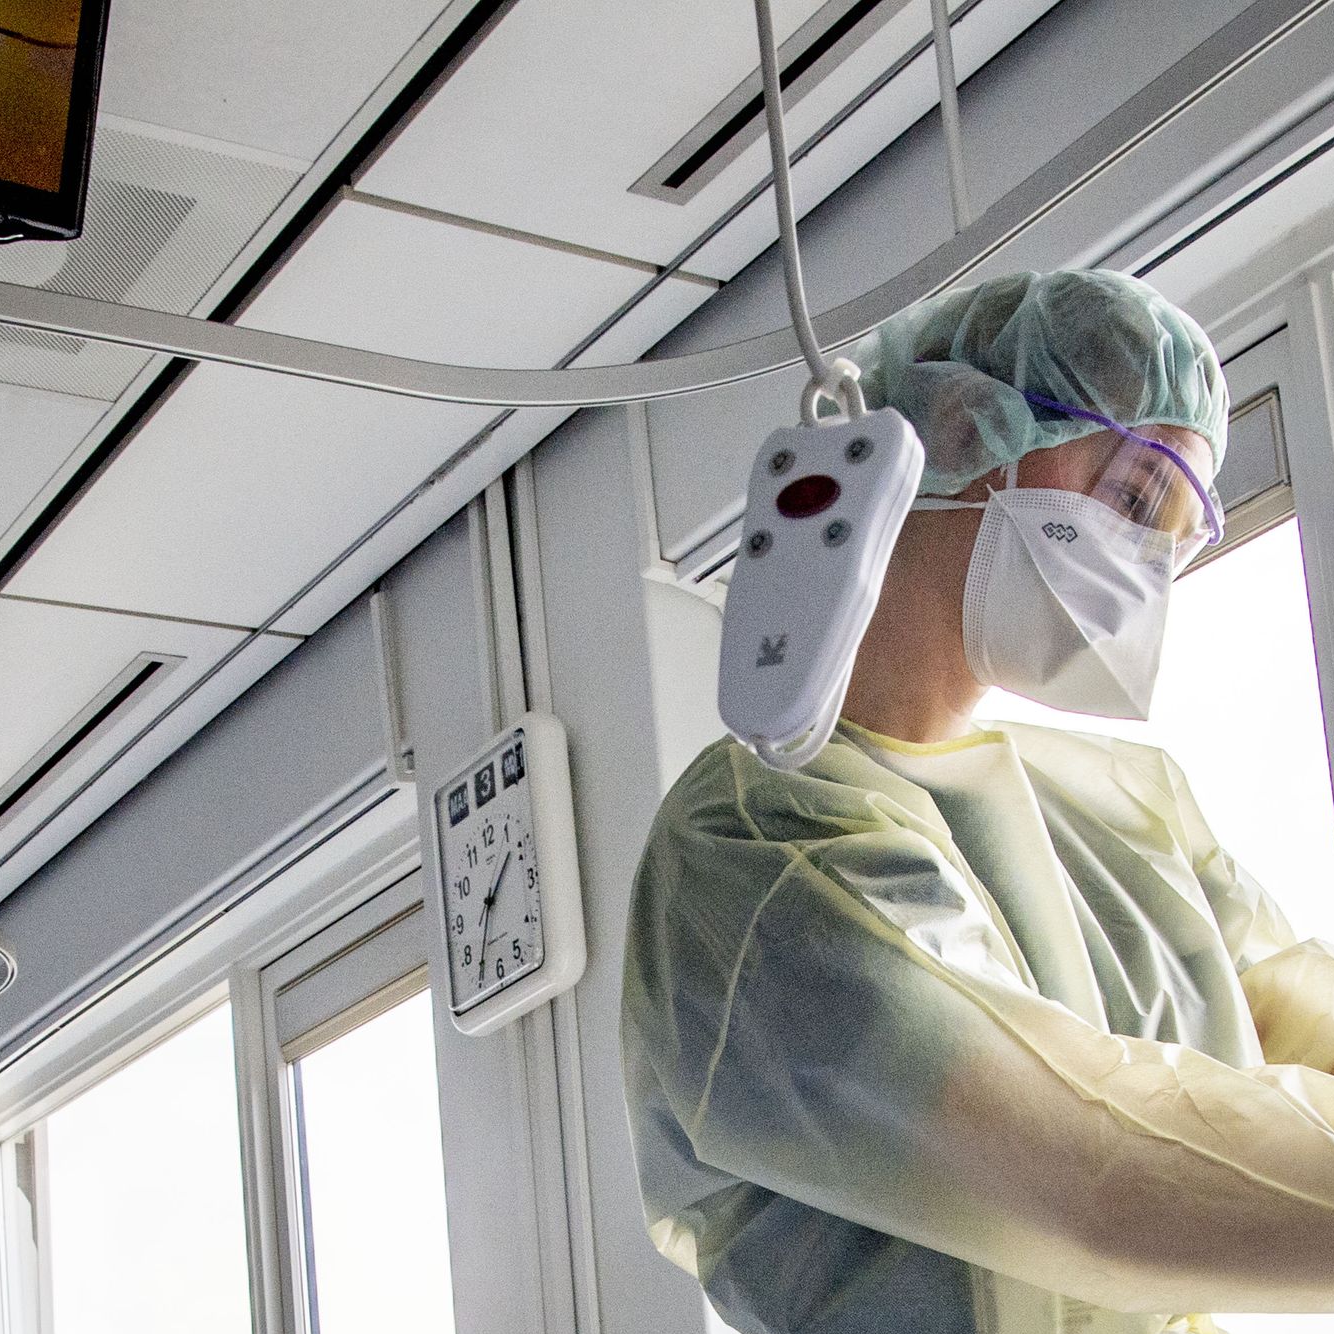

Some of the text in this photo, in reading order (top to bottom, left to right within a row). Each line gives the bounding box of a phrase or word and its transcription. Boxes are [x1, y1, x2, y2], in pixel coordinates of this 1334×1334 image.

[480, 769, 491, 797] 3
[482, 824, 495, 848] 12
[503, 822, 509, 843] 1
[468, 845, 478, 868] 11
[458, 876, 470, 900] 10
[527, 867, 535, 889] 3
[456, 914, 464, 935] 9
[464, 945, 472, 965] 8
[512, 938, 521, 960] 5
[496, 958, 504, 979] 6
